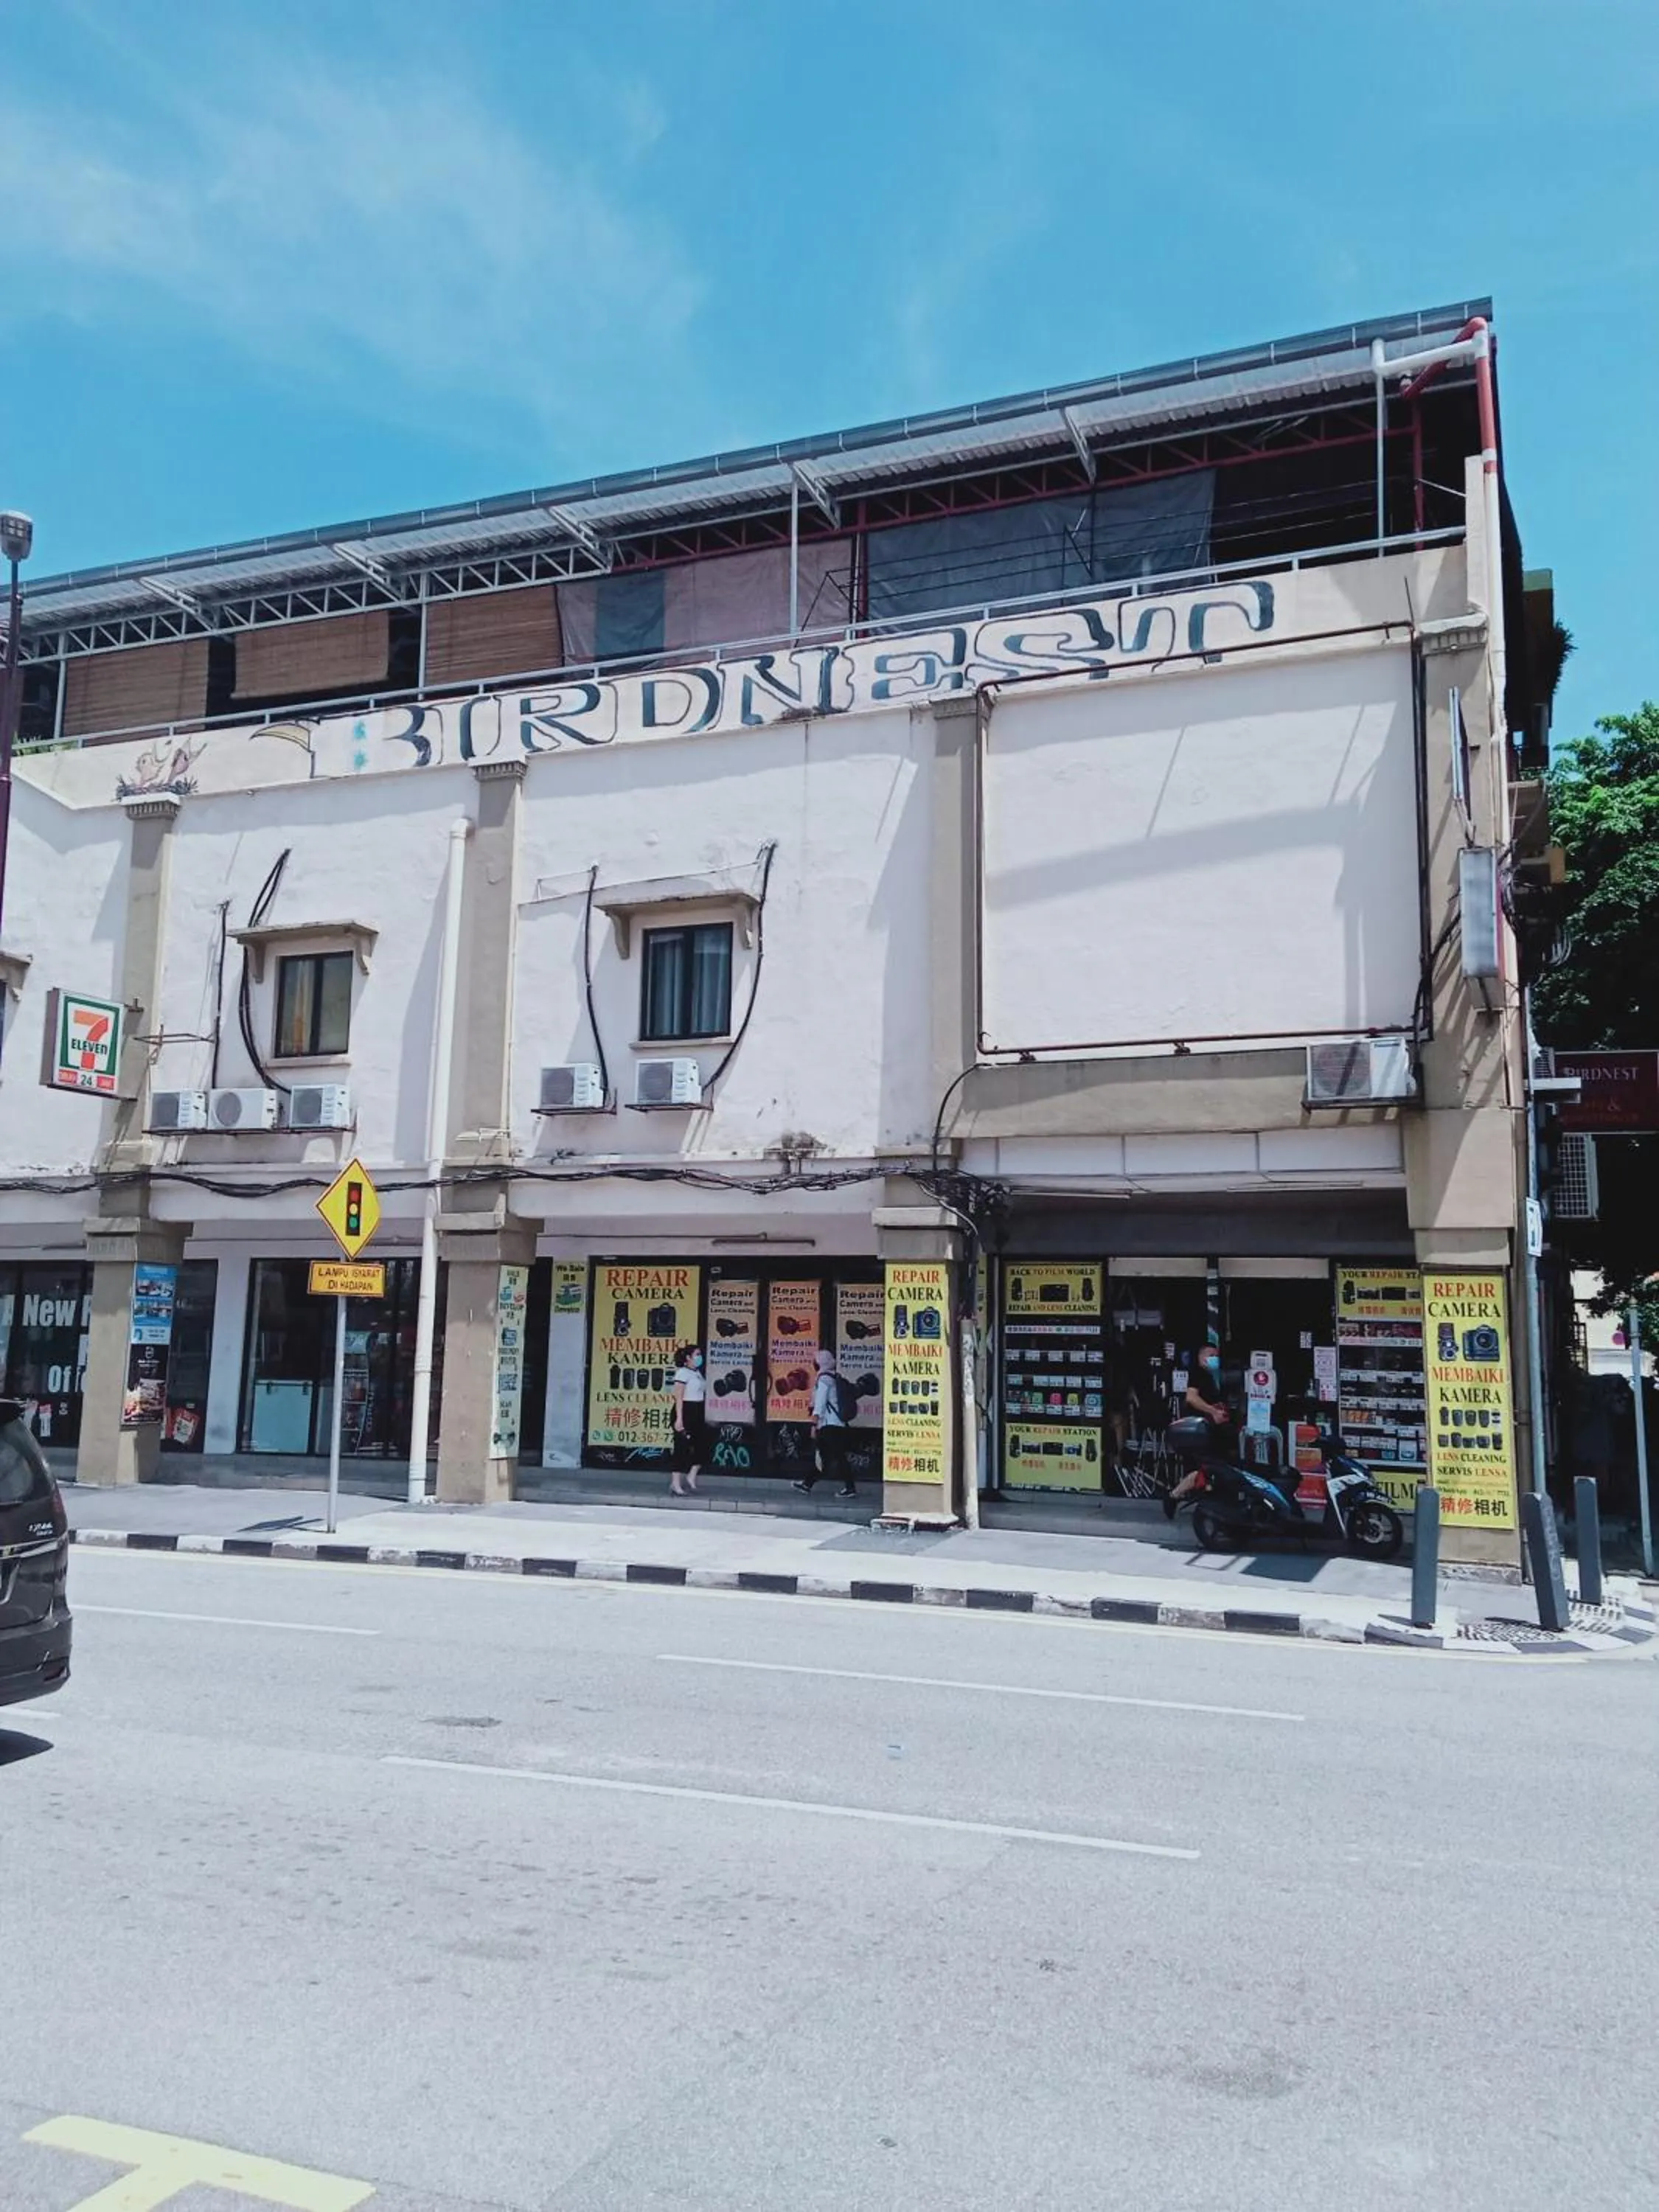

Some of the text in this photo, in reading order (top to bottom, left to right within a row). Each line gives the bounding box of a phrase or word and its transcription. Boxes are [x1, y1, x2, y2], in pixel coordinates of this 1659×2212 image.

[299, 581, 1273, 774] BIRDNEST
[72, 1009, 108, 1069] 7
[81, 1074, 93, 1086] 24
[1563, 1066, 1638, 1081] BIRDNEST
[318, 1267, 349, 1277] LAMPU
[606, 1269, 689, 1287] REPAIR
[893, 1270, 939, 1284] REPAIR
[328, 1279, 338, 1290] DI
[772, 1287, 815, 1295] Repair
[1433, 1282, 1495, 1298] REPAIR
[611, 1287, 684, 1299] CAMERA
[711, 1289, 754, 1298] Repair
[771, 1295, 804, 1304] Camera
[888, 1287, 943, 1301] CAMERA
[710, 1298, 742, 1306] Camera
[840, 1300, 874, 1308] Camera
[22, 1295, 77, 1327] New
[1428, 1301, 1502, 1318] CAMERA
[888, 1343, 943, 1357] MEMBAIKI
[893, 1362, 940, 1375] KAMERA
[1432, 1366, 1504, 1383] MEMBAIKI
[597, 1391, 625, 1402] LENS
[1440, 1386, 1502, 1404] KAMERA
[905, 1418, 942, 1427] CLEANING
[1062, 1427, 1097, 1436] STATION
[888, 1456, 940, 1472] 精修相机
[1437, 1453, 1507, 1464] LENS CLEANING
[1437, 1465, 1508, 1478] SERVIS LENSA
[1440, 1497, 1509, 1517] 精修相机
